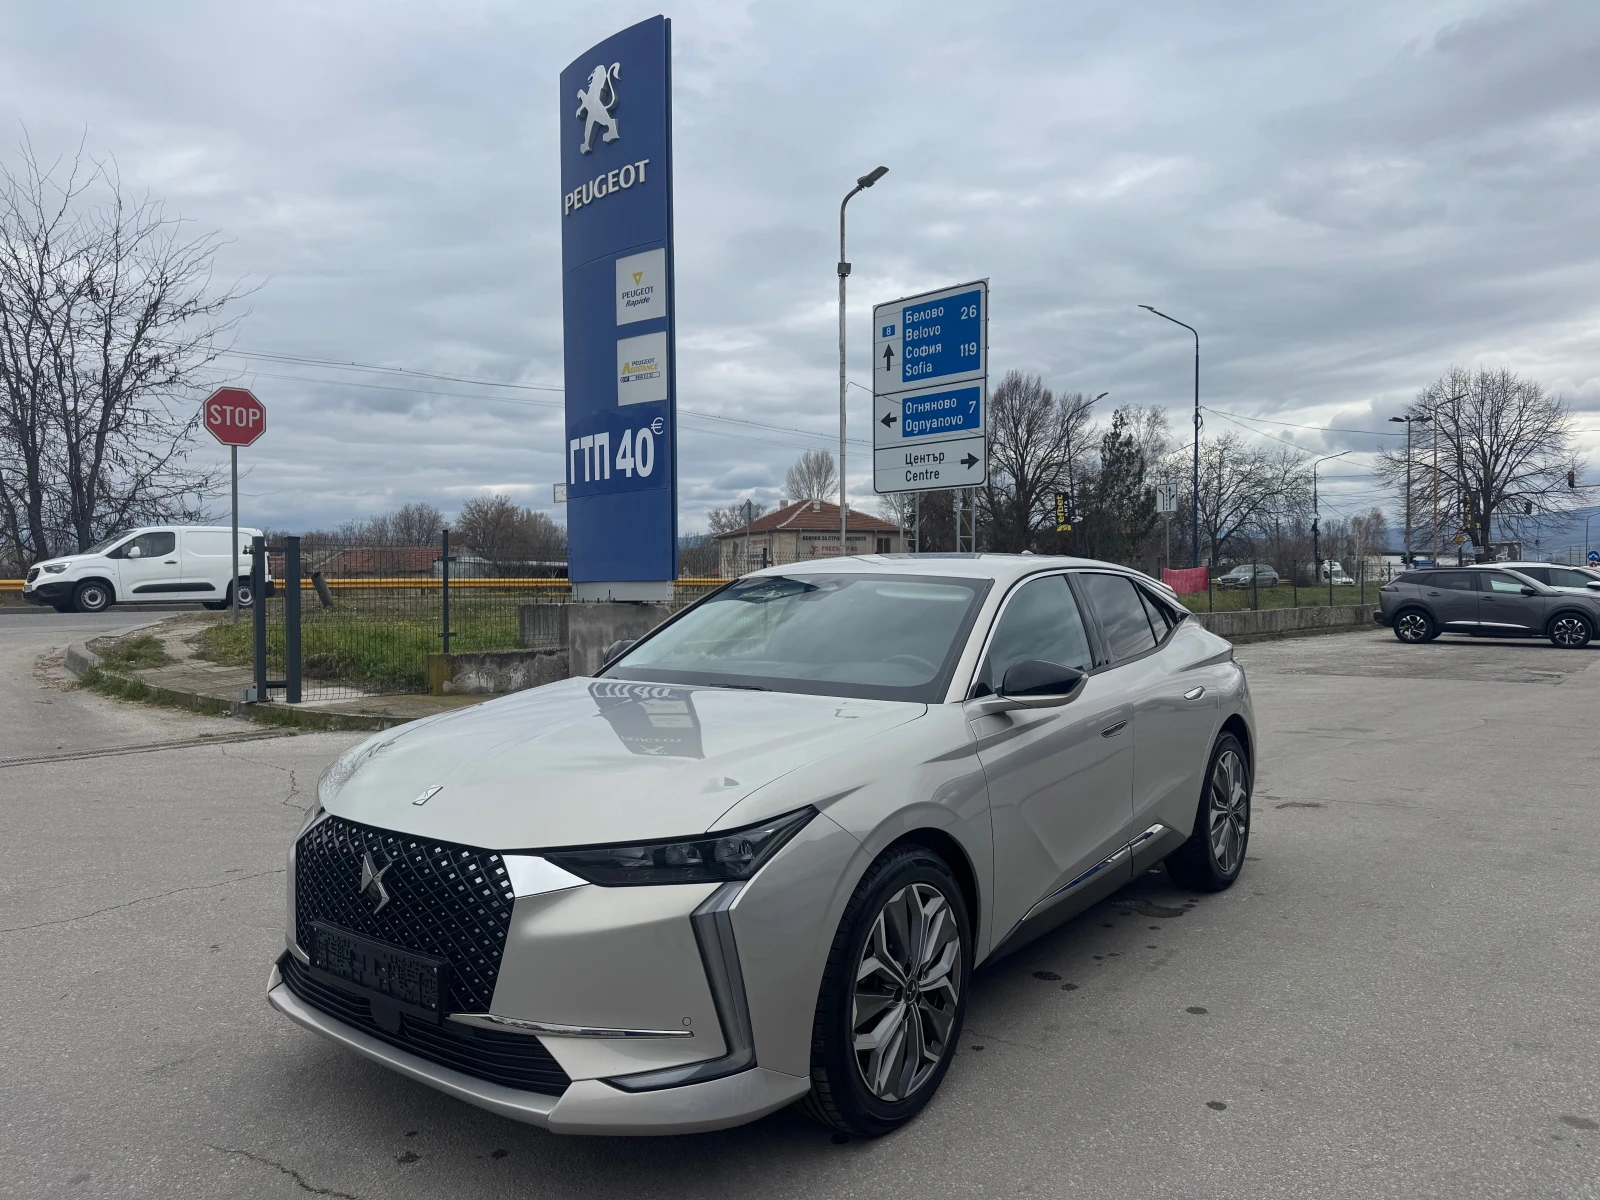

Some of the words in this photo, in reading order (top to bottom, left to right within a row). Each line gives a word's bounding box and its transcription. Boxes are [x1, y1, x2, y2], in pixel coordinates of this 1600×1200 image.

[564, 158, 650, 216] PEUGEOT
[621, 285, 654, 299] PEUGEOT
[625, 296, 651, 308] Rapide
[905, 306, 944, 324] Белово
[960, 304, 977, 320] 26
[886, 327, 892, 336] 8
[905, 325, 941, 341] Belovo
[905, 343, 942, 359] София
[960, 342, 977, 357] 119
[631, 357, 655, 367] PEUGEOT
[905, 361, 932, 376] Sofia
[905, 398, 957, 415] Огняново
[968, 400, 977, 414] 7
[209, 404, 261, 428] STOP
[905, 415, 963, 434] Ognyanovo
[569, 431, 611, 485] ГТП
[905, 452, 945, 466] Център
[905, 469, 940, 482] Centre
